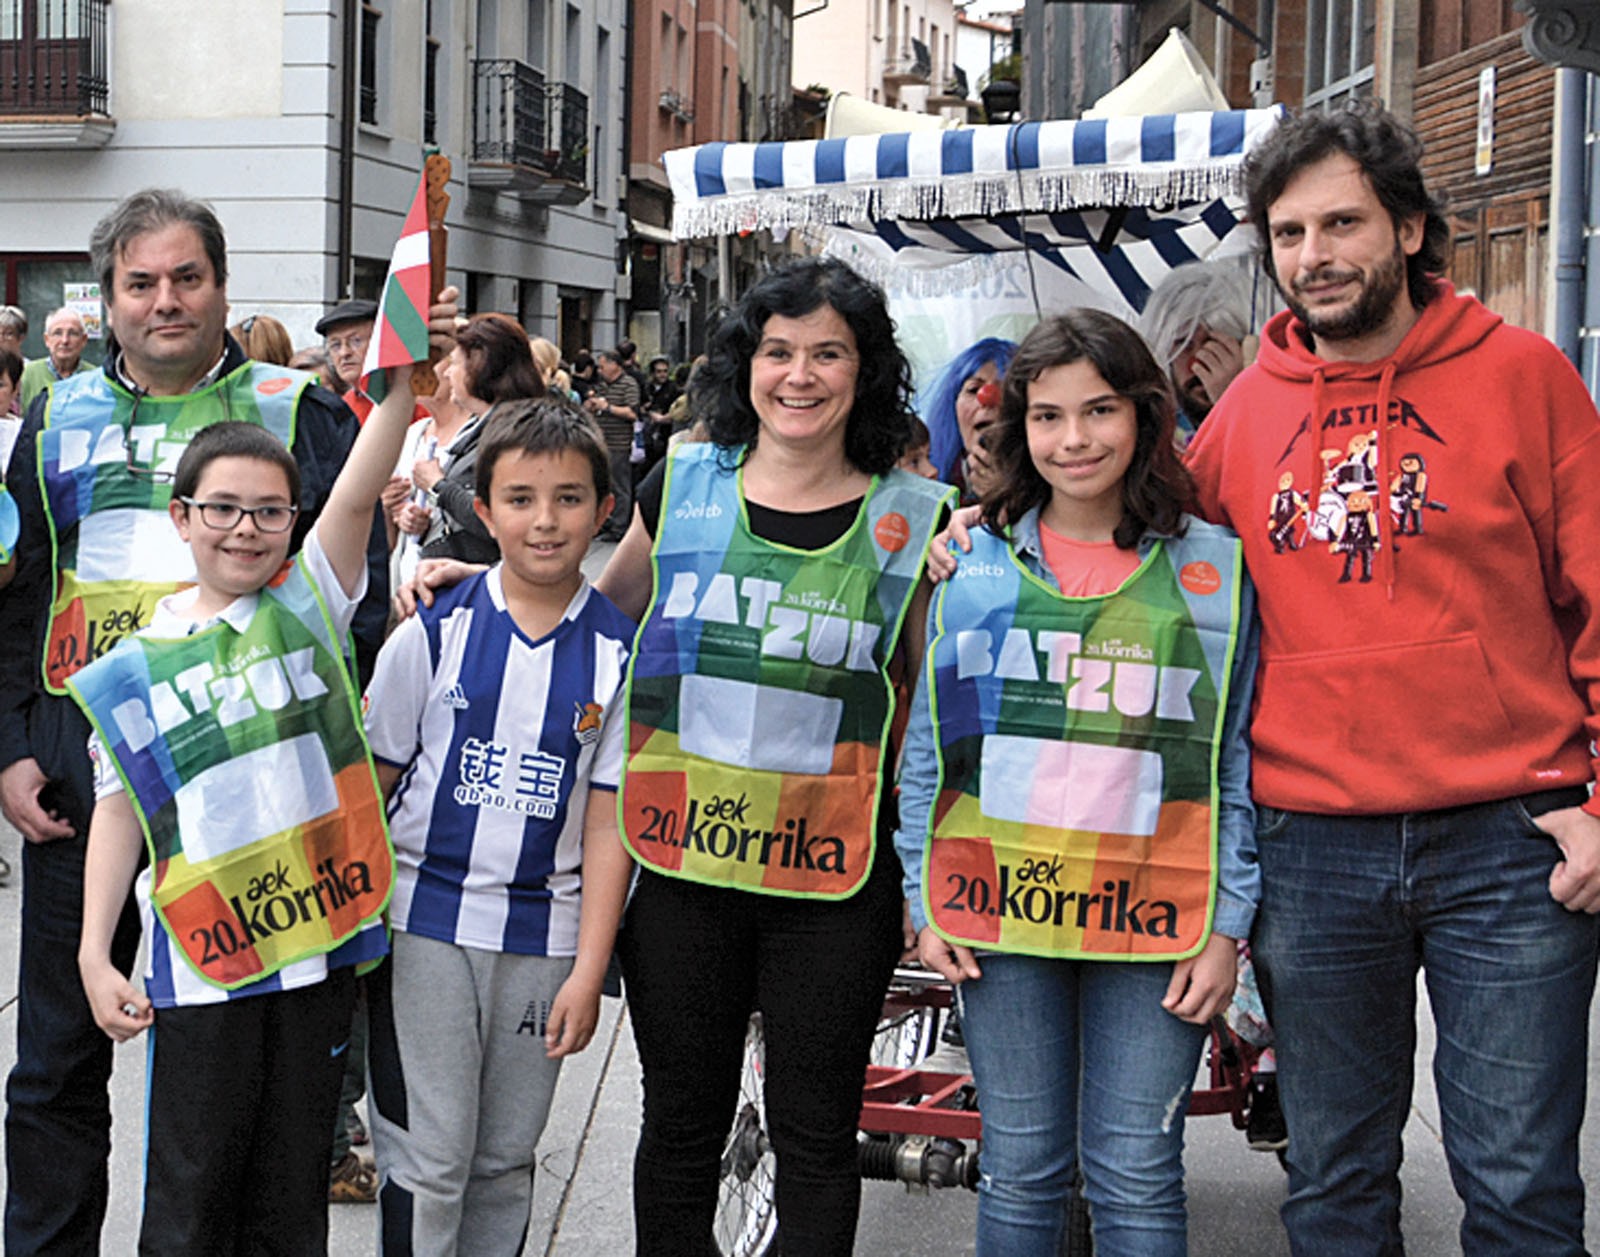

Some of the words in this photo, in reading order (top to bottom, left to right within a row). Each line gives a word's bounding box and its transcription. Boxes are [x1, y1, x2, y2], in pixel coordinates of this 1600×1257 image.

[59, 423, 167, 474] BAT
[662, 572, 782, 628] BAT
[761, 606, 881, 673] ZUK
[957, 628, 1081, 684] BAT
[112, 661, 215, 754] BAT
[209, 646, 329, 728] ZUK
[1067, 658, 1201, 722] ZUK
[455, 786, 555, 818] qbao.com
[703, 792, 751, 824] aek
[246, 859, 293, 902] aek
[1016, 853, 1064, 886] aek
